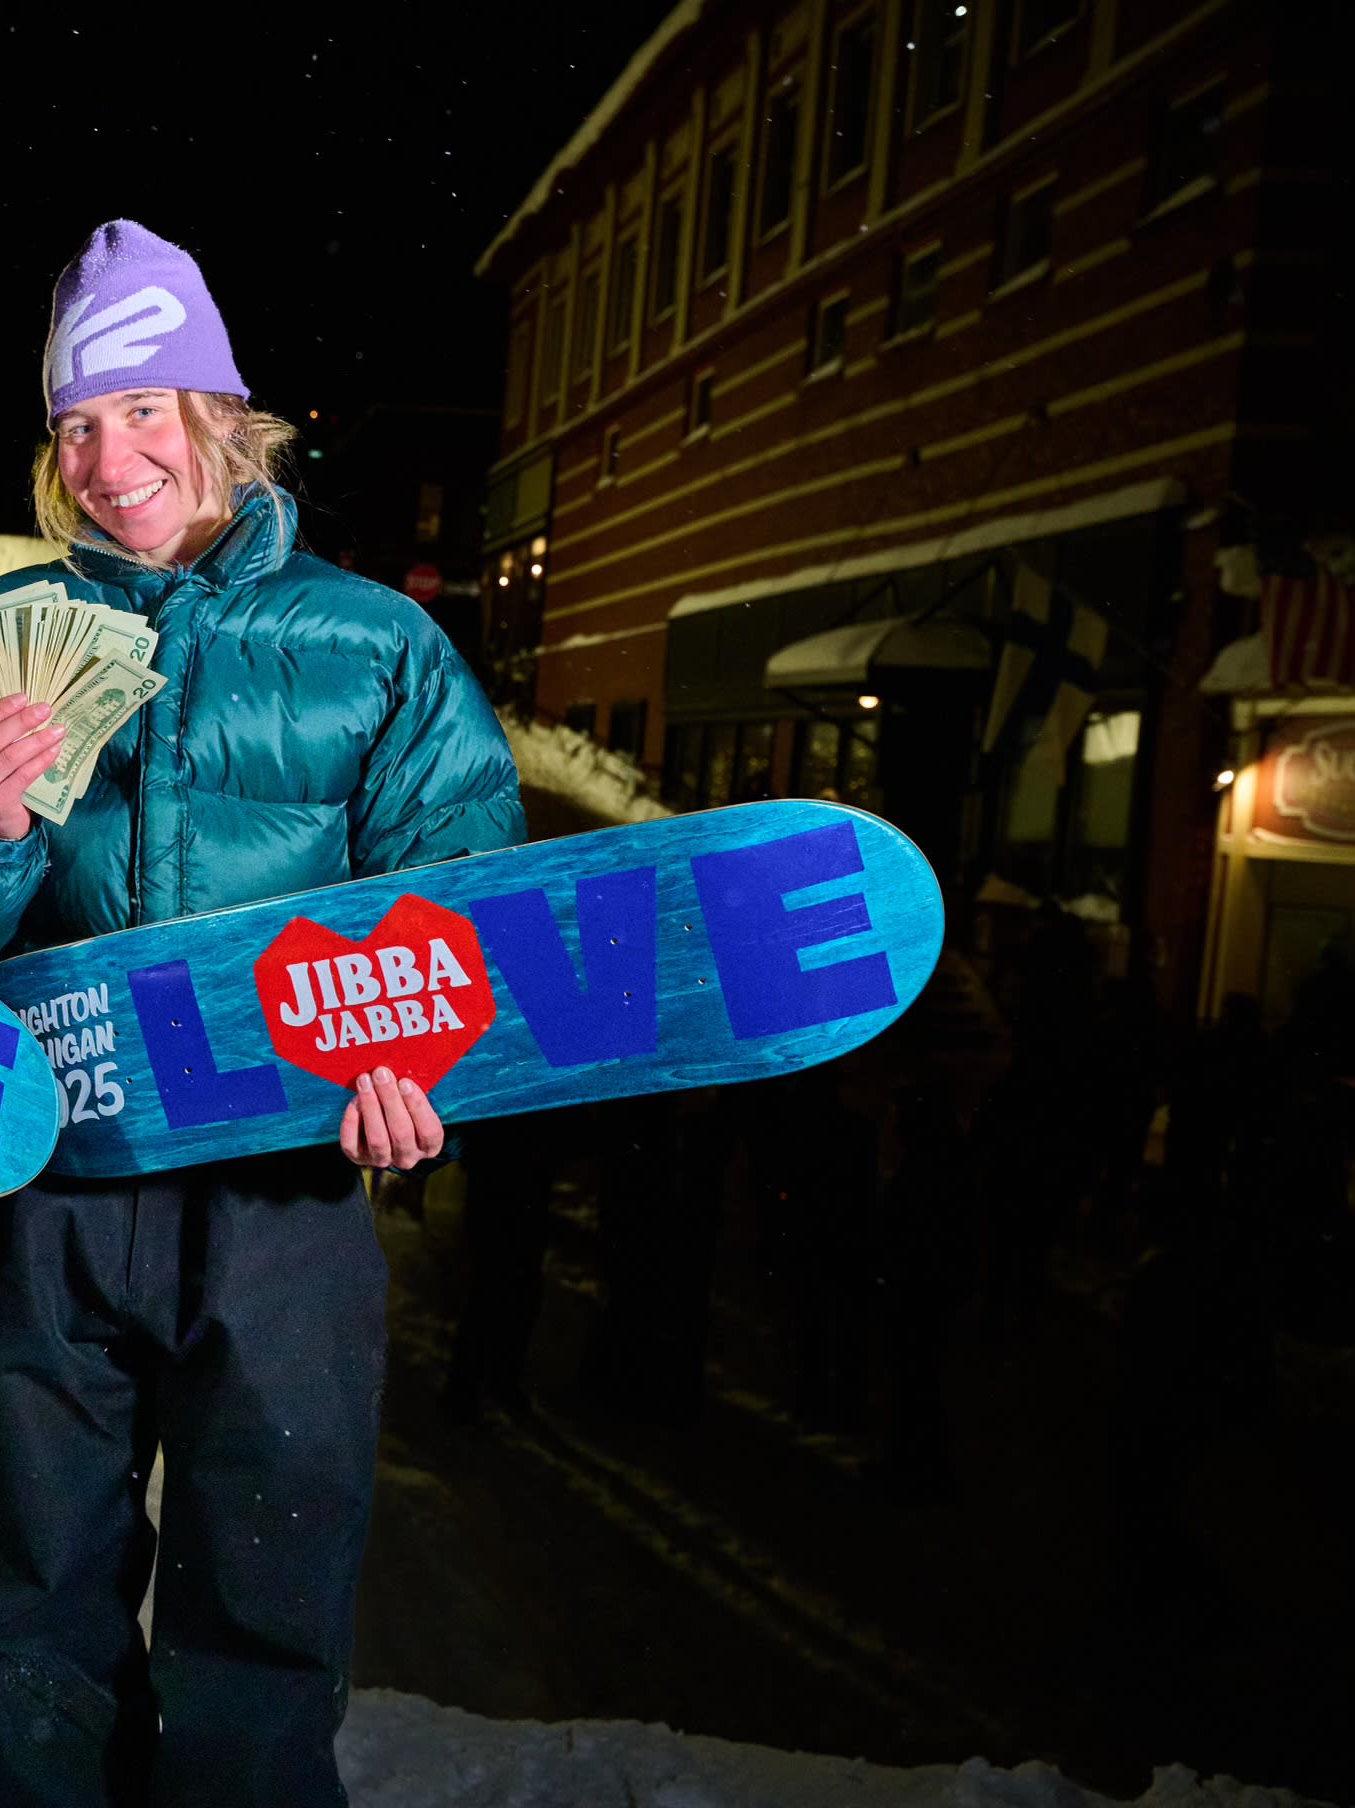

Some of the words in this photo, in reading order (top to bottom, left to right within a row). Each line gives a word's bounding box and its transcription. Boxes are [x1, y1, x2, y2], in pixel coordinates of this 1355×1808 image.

[130, 636, 150, 662] 20
[133, 679, 156, 699] 20
[279, 938, 472, 1027] JIBBA
[315, 994, 465, 1052] JABBA
